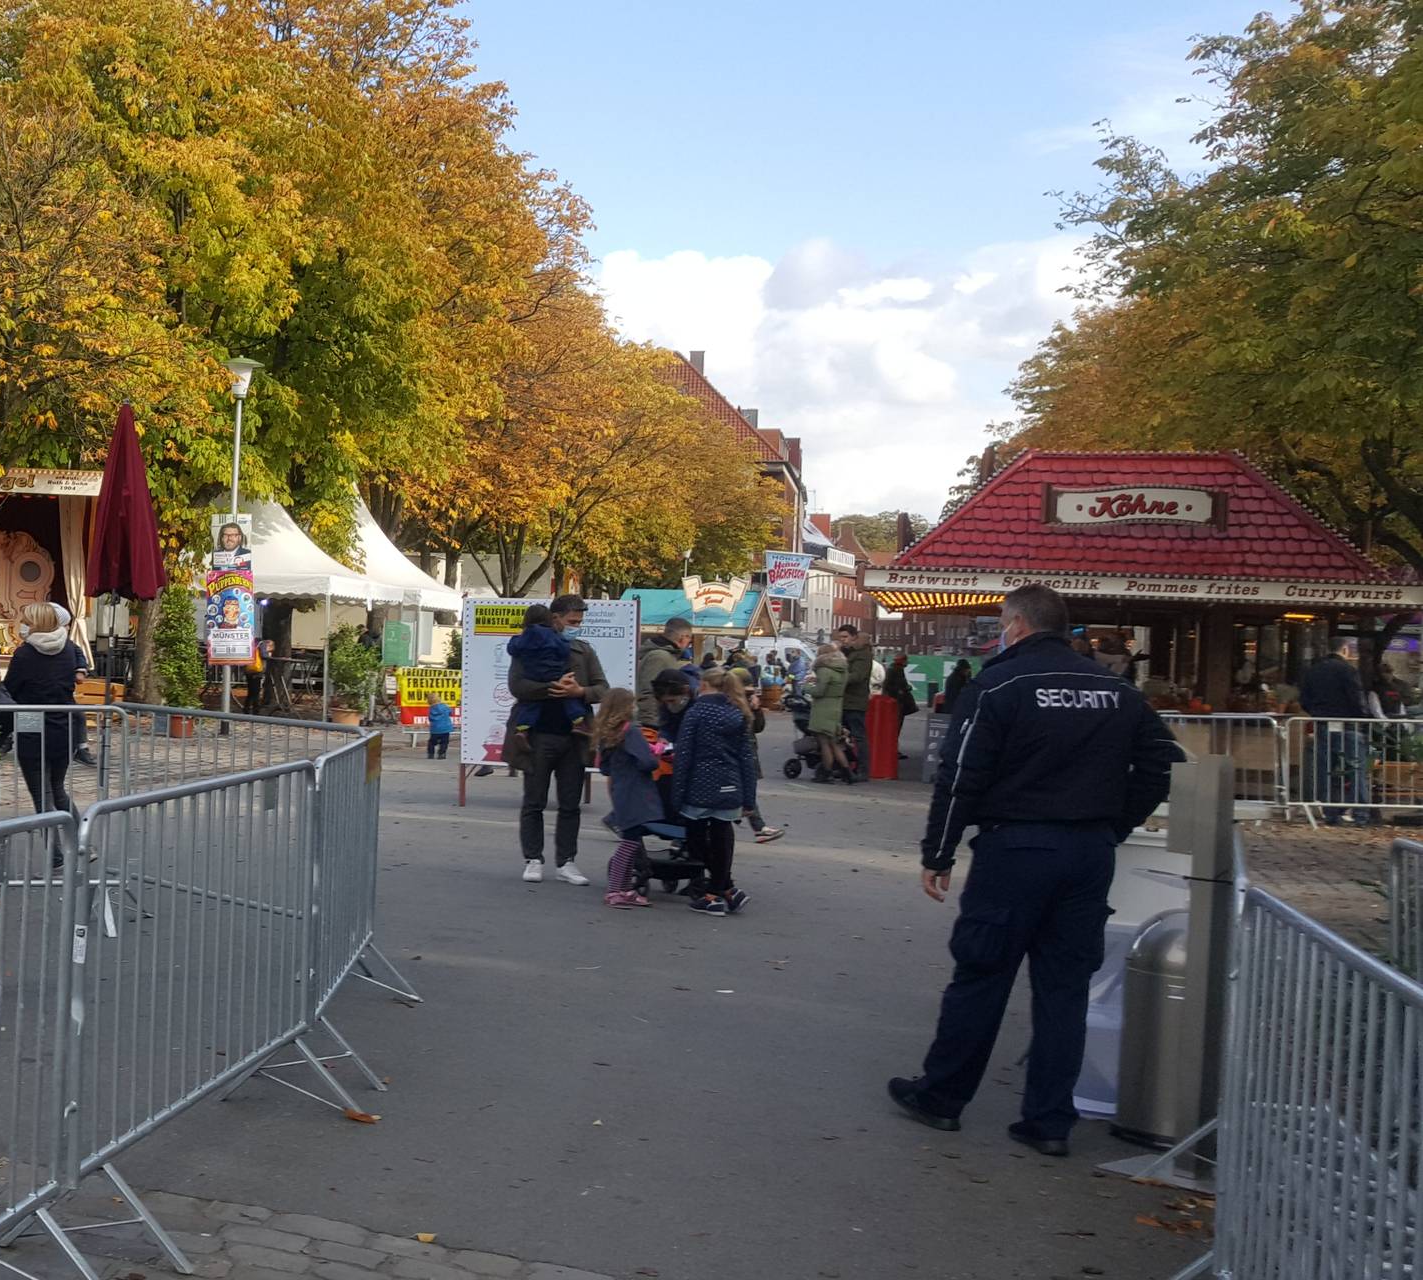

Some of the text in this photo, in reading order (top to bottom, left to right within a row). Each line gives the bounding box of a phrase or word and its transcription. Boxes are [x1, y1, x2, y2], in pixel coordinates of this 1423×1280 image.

[1088, 493, 1179, 519] Köhne
[886, 572, 979, 588] Bratwurst
[1125, 580, 1198, 594] Pommes
[1205, 582, 1260, 596] frites
[1284, 584, 1404, 601] Currywurst
[475, 616, 510, 625] MÜNSTER
[212, 631, 250, 641] MÜNSTER
[1035, 688, 1120, 709] SECURITY
